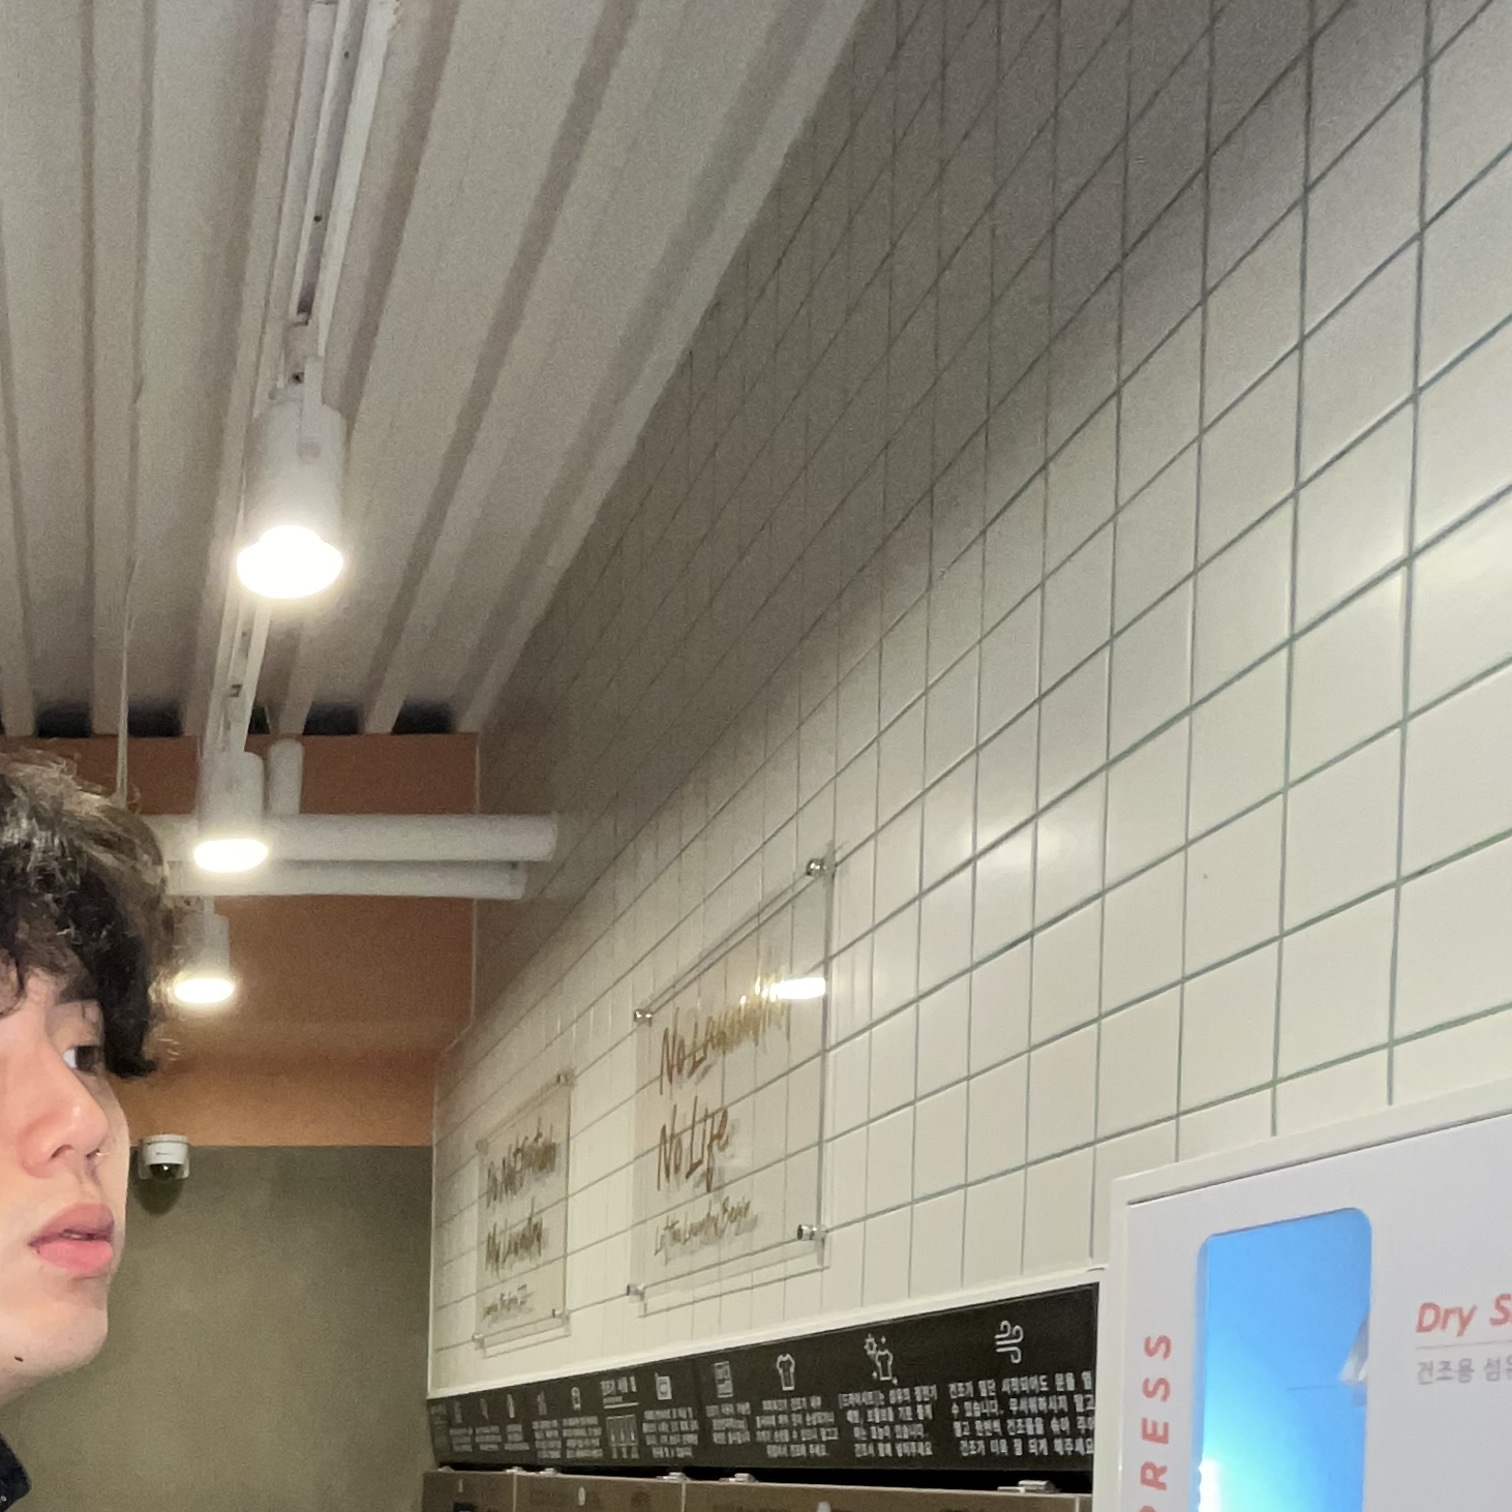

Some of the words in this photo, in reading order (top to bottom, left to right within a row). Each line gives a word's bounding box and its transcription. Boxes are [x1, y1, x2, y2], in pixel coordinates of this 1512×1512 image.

[656, 1104, 683, 1191] No
[685, 1095, 729, 1193] Life
[1415, 1302, 1477, 1337] Dry
[1417, 1358, 1475, 1386] 건조용
